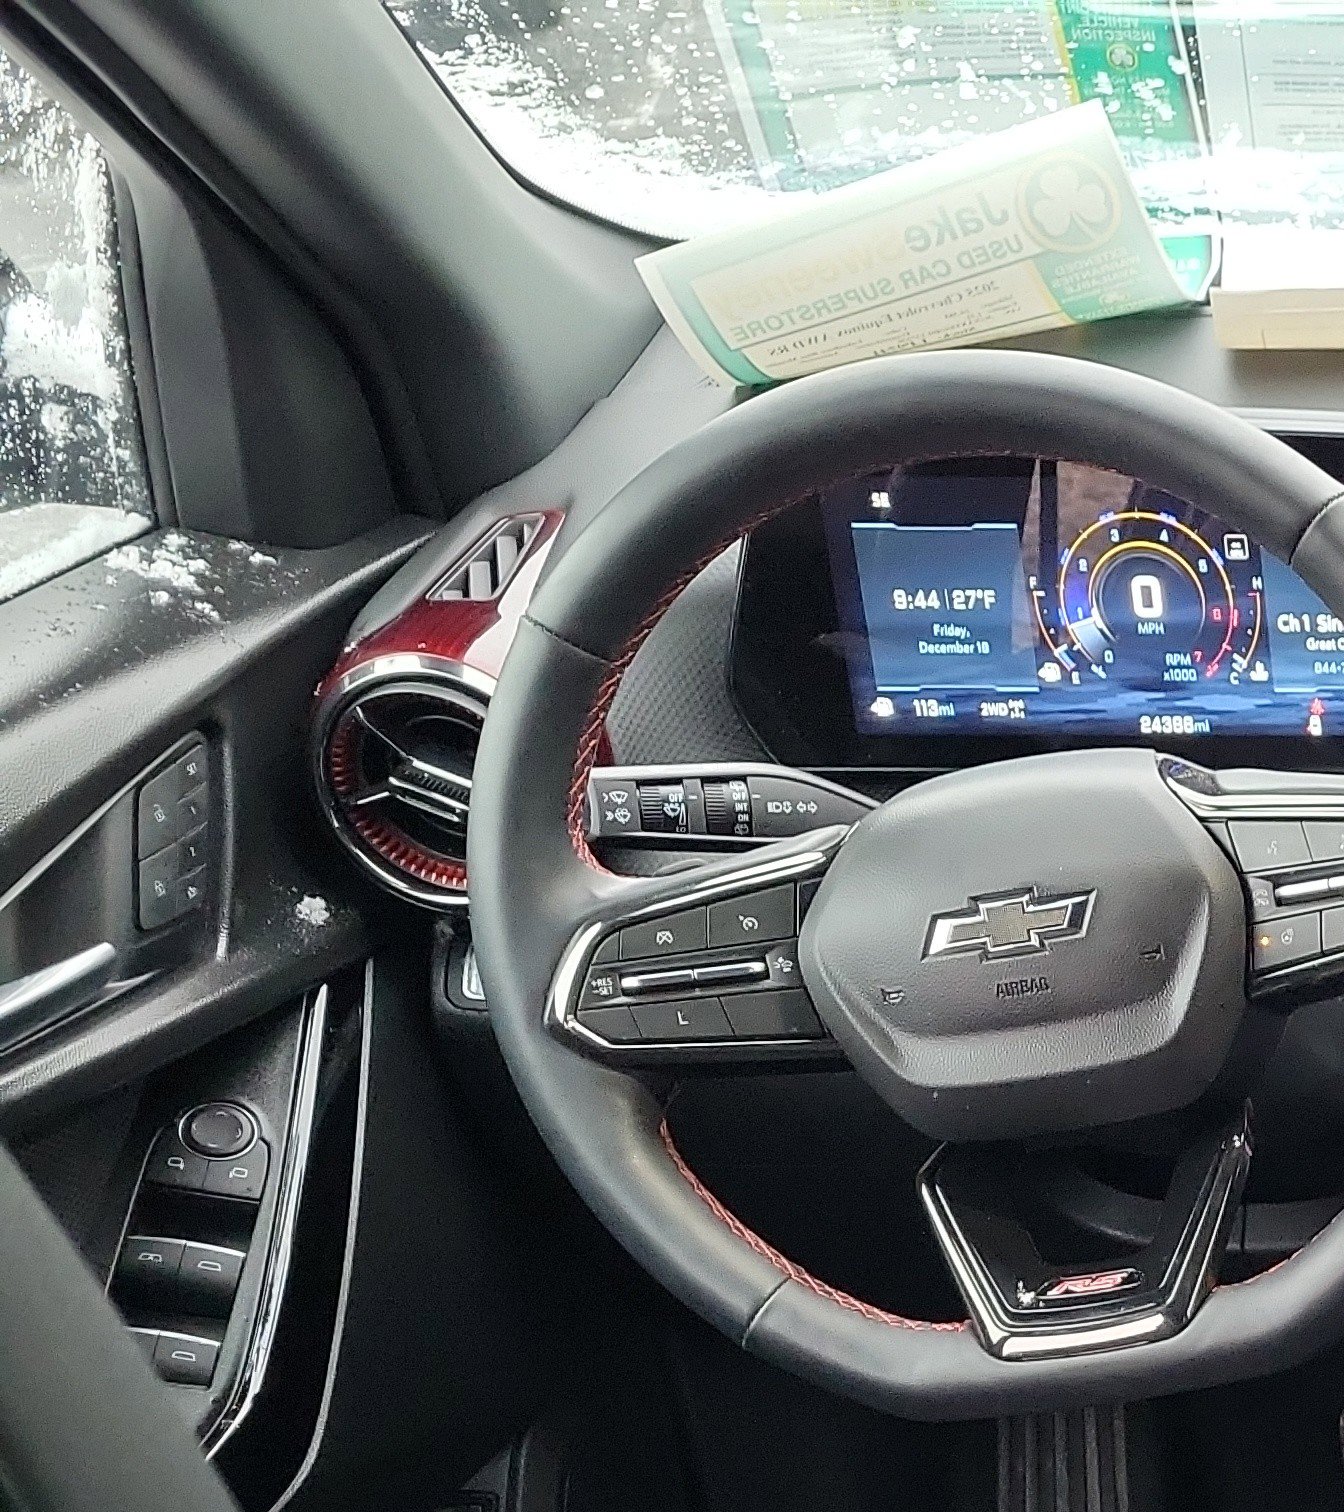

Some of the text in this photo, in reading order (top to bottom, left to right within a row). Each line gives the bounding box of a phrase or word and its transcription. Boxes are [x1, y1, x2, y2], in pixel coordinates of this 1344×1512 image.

[1130, 574, 1163, 619] 0
[1137, 621, 1165, 636] MPH
[918, 641, 974, 655] December
[1165, 652, 1192, 666] RPM
[996, 976, 1050, 998] AIRBAG
